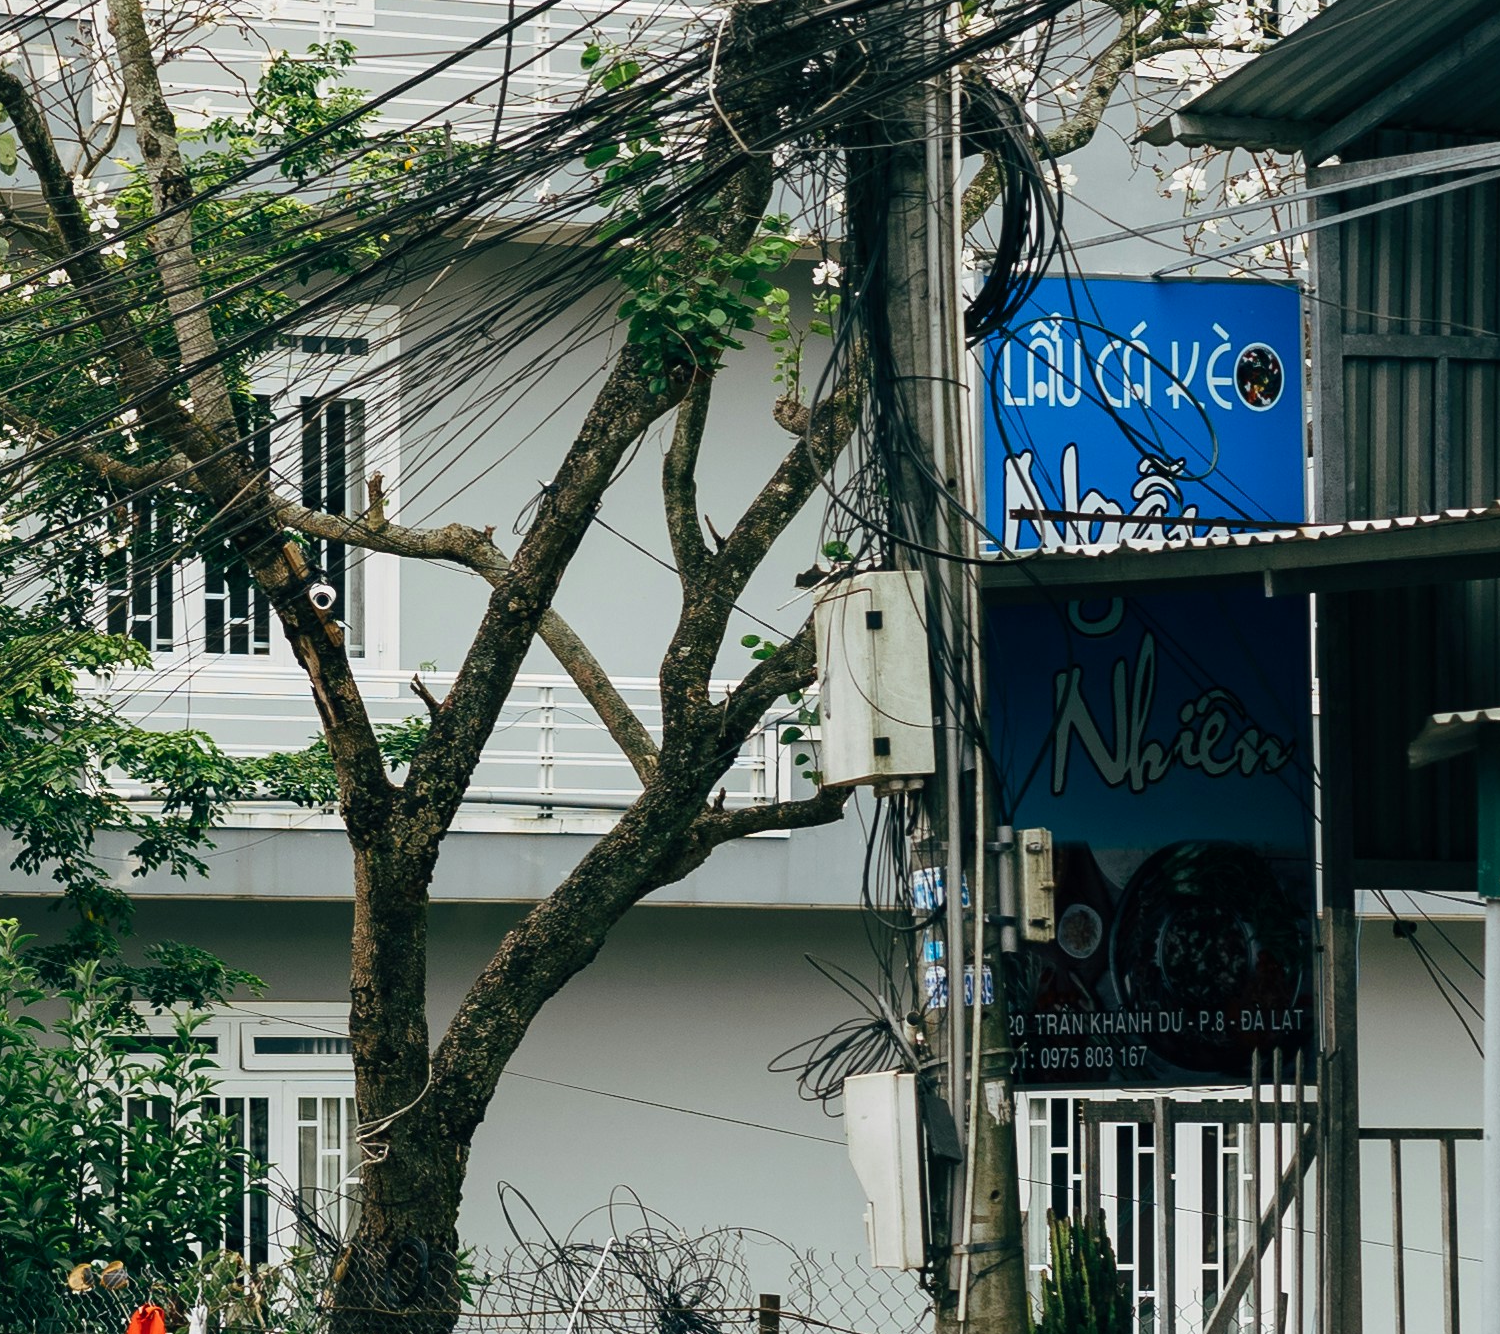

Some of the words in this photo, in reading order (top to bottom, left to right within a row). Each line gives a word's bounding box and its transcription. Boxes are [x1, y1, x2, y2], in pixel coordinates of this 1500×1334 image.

[1003, 312, 1082, 408] LẨU
[1095, 321, 1151, 409] CÁ
[1053, 630, 1296, 795] Nhiên
[1035, 1003, 1084, 1036] TRẦN
[1090, 1006, 1152, 1035] KHÁNH
[1159, 1007, 1183, 1033] DƯ
[1199, 1010, 1225, 1032] P.8
[1241, 1003, 1265, 1031] ĐÀ
[1271, 1009, 1304, 1035] LẠT
[1040, 1047, 1079, 1069] 0975
[1085, 1046, 1113, 1068] 803
[1120, 1045, 1148, 1067] 167
